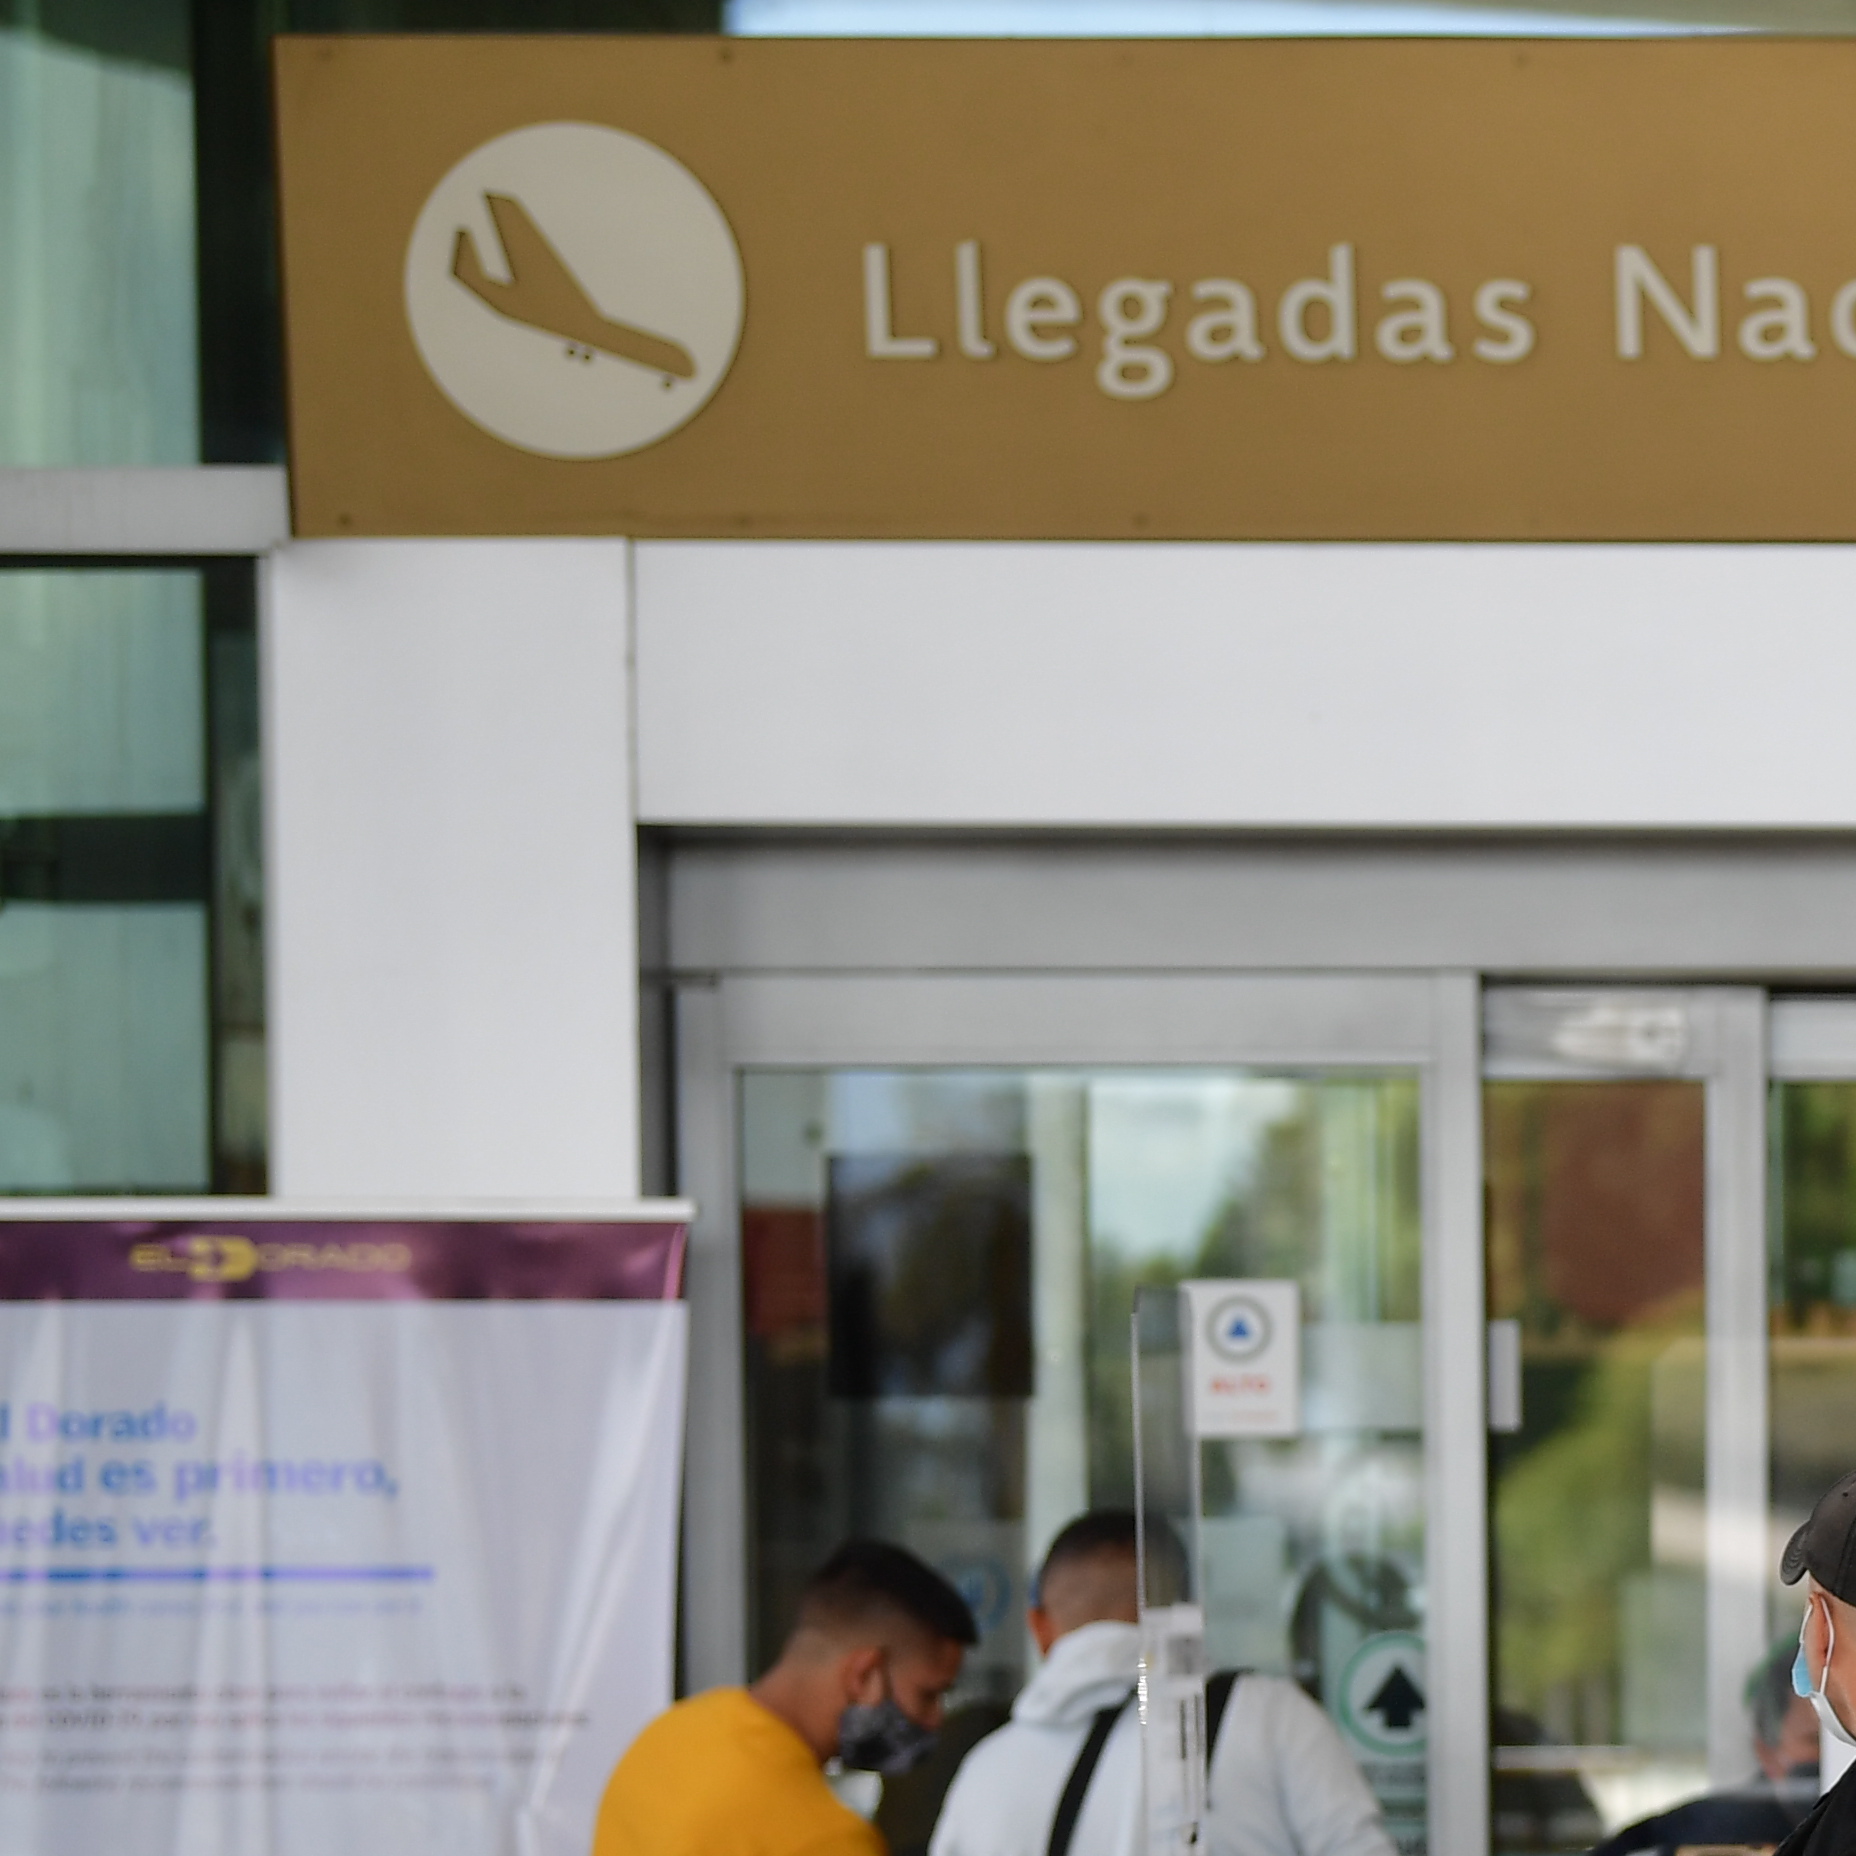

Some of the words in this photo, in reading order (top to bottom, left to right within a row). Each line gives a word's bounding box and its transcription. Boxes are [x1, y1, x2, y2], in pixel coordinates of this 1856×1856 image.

[863, 240, 1534, 398] Llegadas
[26, 1402, 196, 1442] Dorado
[101, 1459, 156, 1493] es
[175, 1450, 399, 1502] primero,
